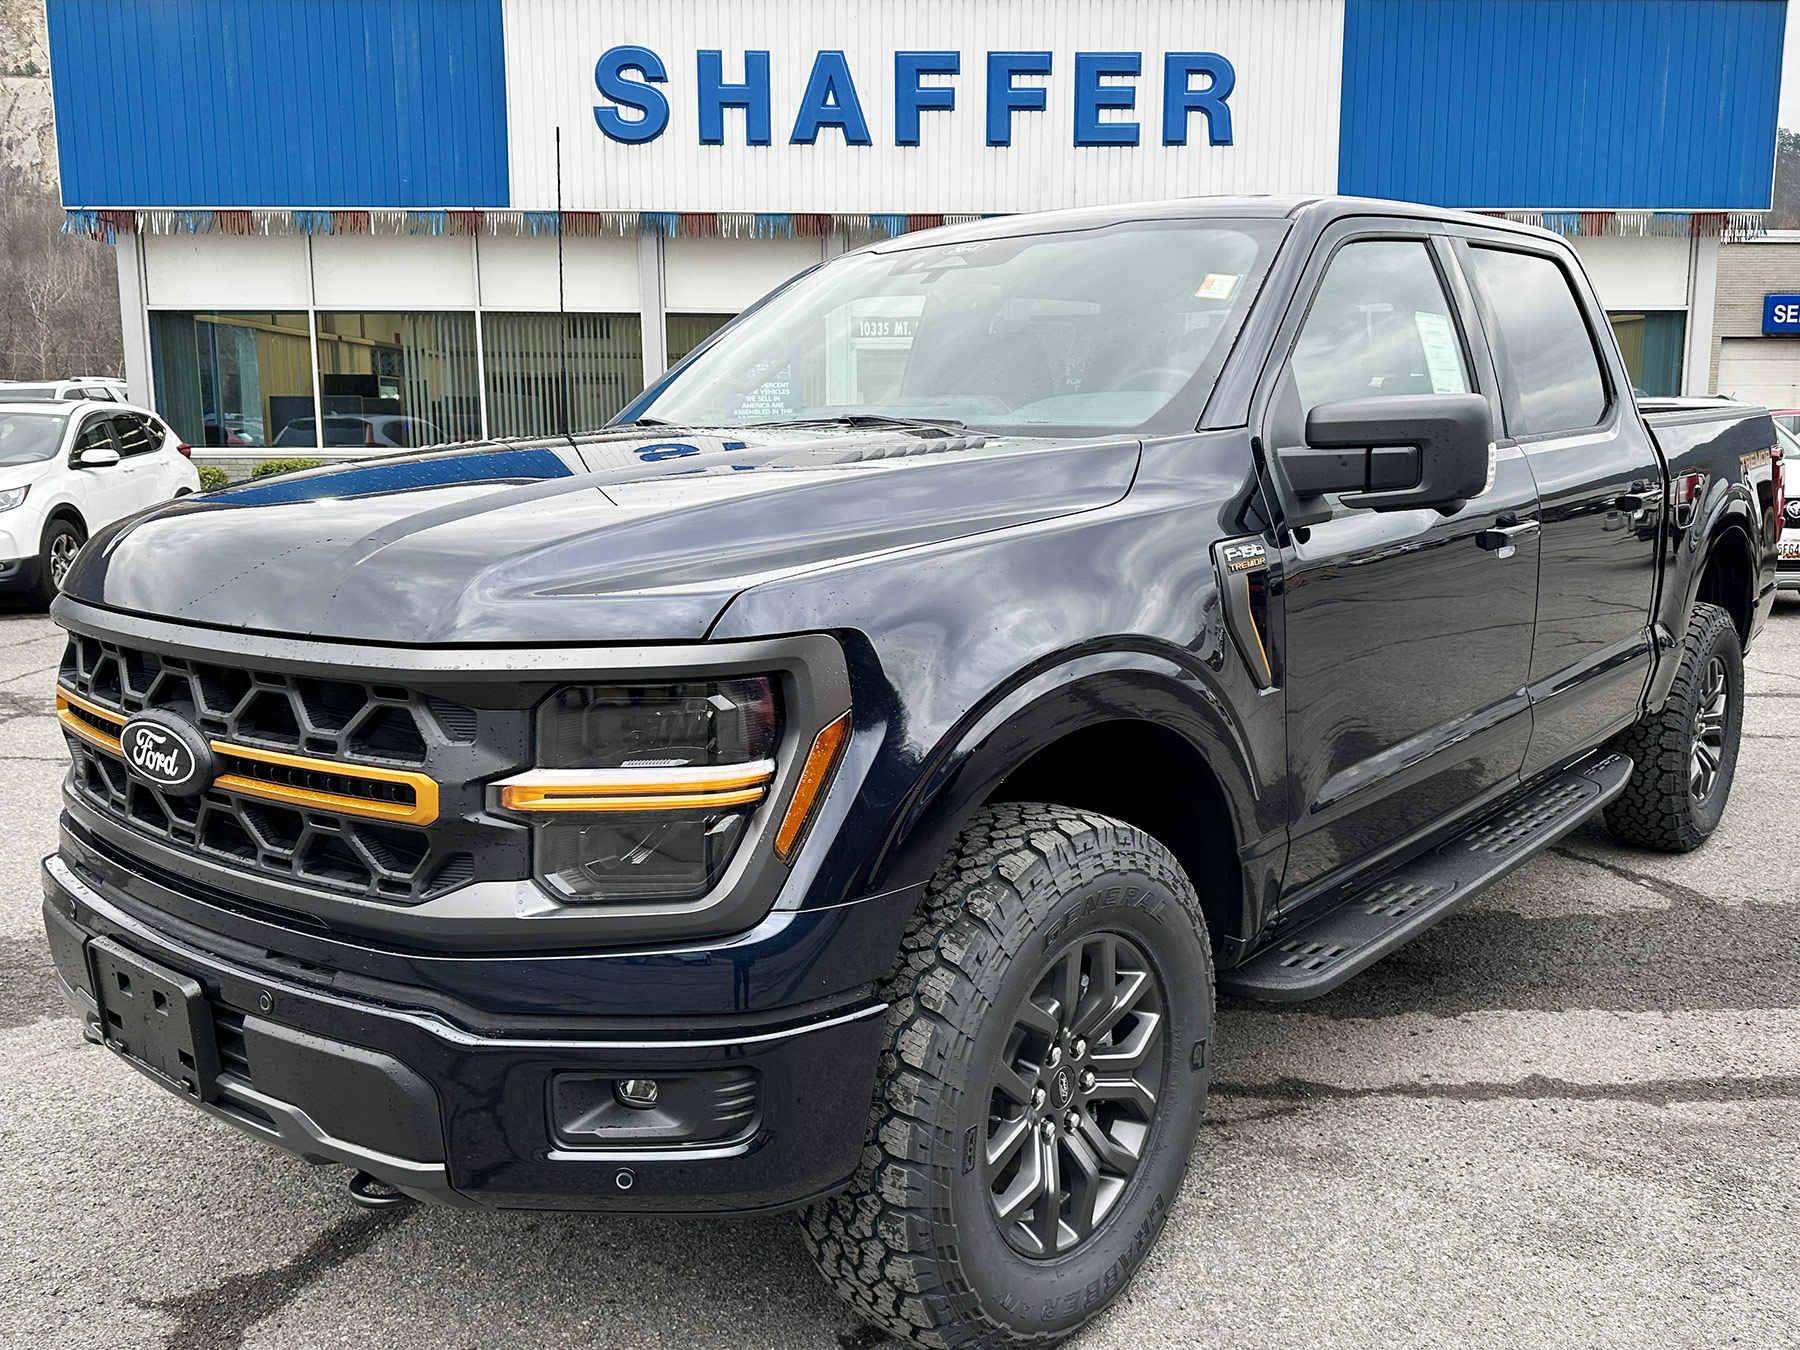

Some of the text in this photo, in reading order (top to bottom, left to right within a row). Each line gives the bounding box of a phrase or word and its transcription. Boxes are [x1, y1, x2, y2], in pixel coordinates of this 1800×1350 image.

[593, 44, 1236, 146] SHAFFER
[860, 321, 912, 336] 10335 MT.
[1773, 304, 1800, 323] SE
[1224, 543, 1266, 562] F-150
[1229, 557, 1266, 573] TREMOR
[133, 728, 179, 777] Ford
[1042, 885, 1167, 955] GENERAL
[1041, 1193, 1165, 1321] GRABBER
